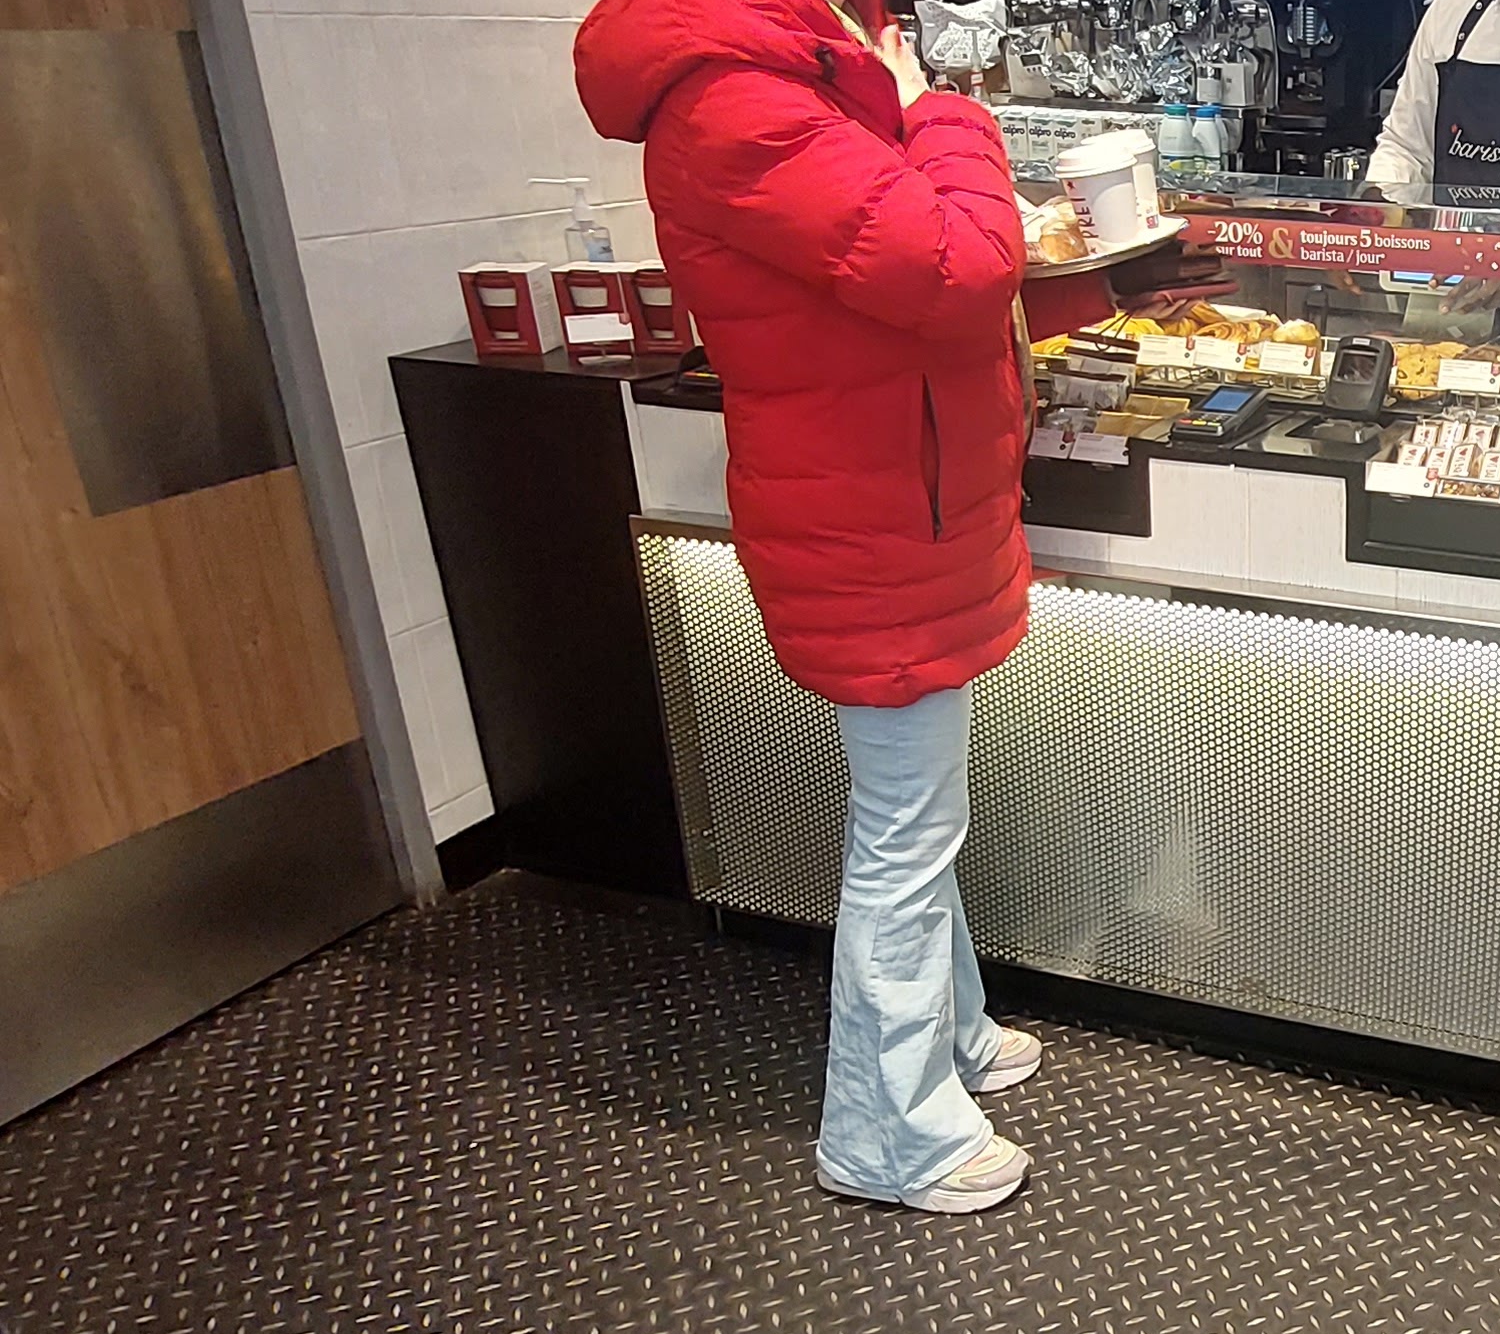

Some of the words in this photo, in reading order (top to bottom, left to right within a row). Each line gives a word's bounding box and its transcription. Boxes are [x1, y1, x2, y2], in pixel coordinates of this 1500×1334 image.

[1002, 124, 1026, 137] alpro
[1029, 125, 1052, 139] alpro
[1054, 127, 1077, 140] alpro
[1070, 197, 1100, 240] PRET
[1207, 220, 1264, 245] -20%
[1300, 230, 1358, 248] toujours
[1359, 229, 1372, 249] 5
[1374, 233, 1431, 251] boissons
[1237, 244, 1263, 258] tout
[1300, 248, 1345, 263] barista
